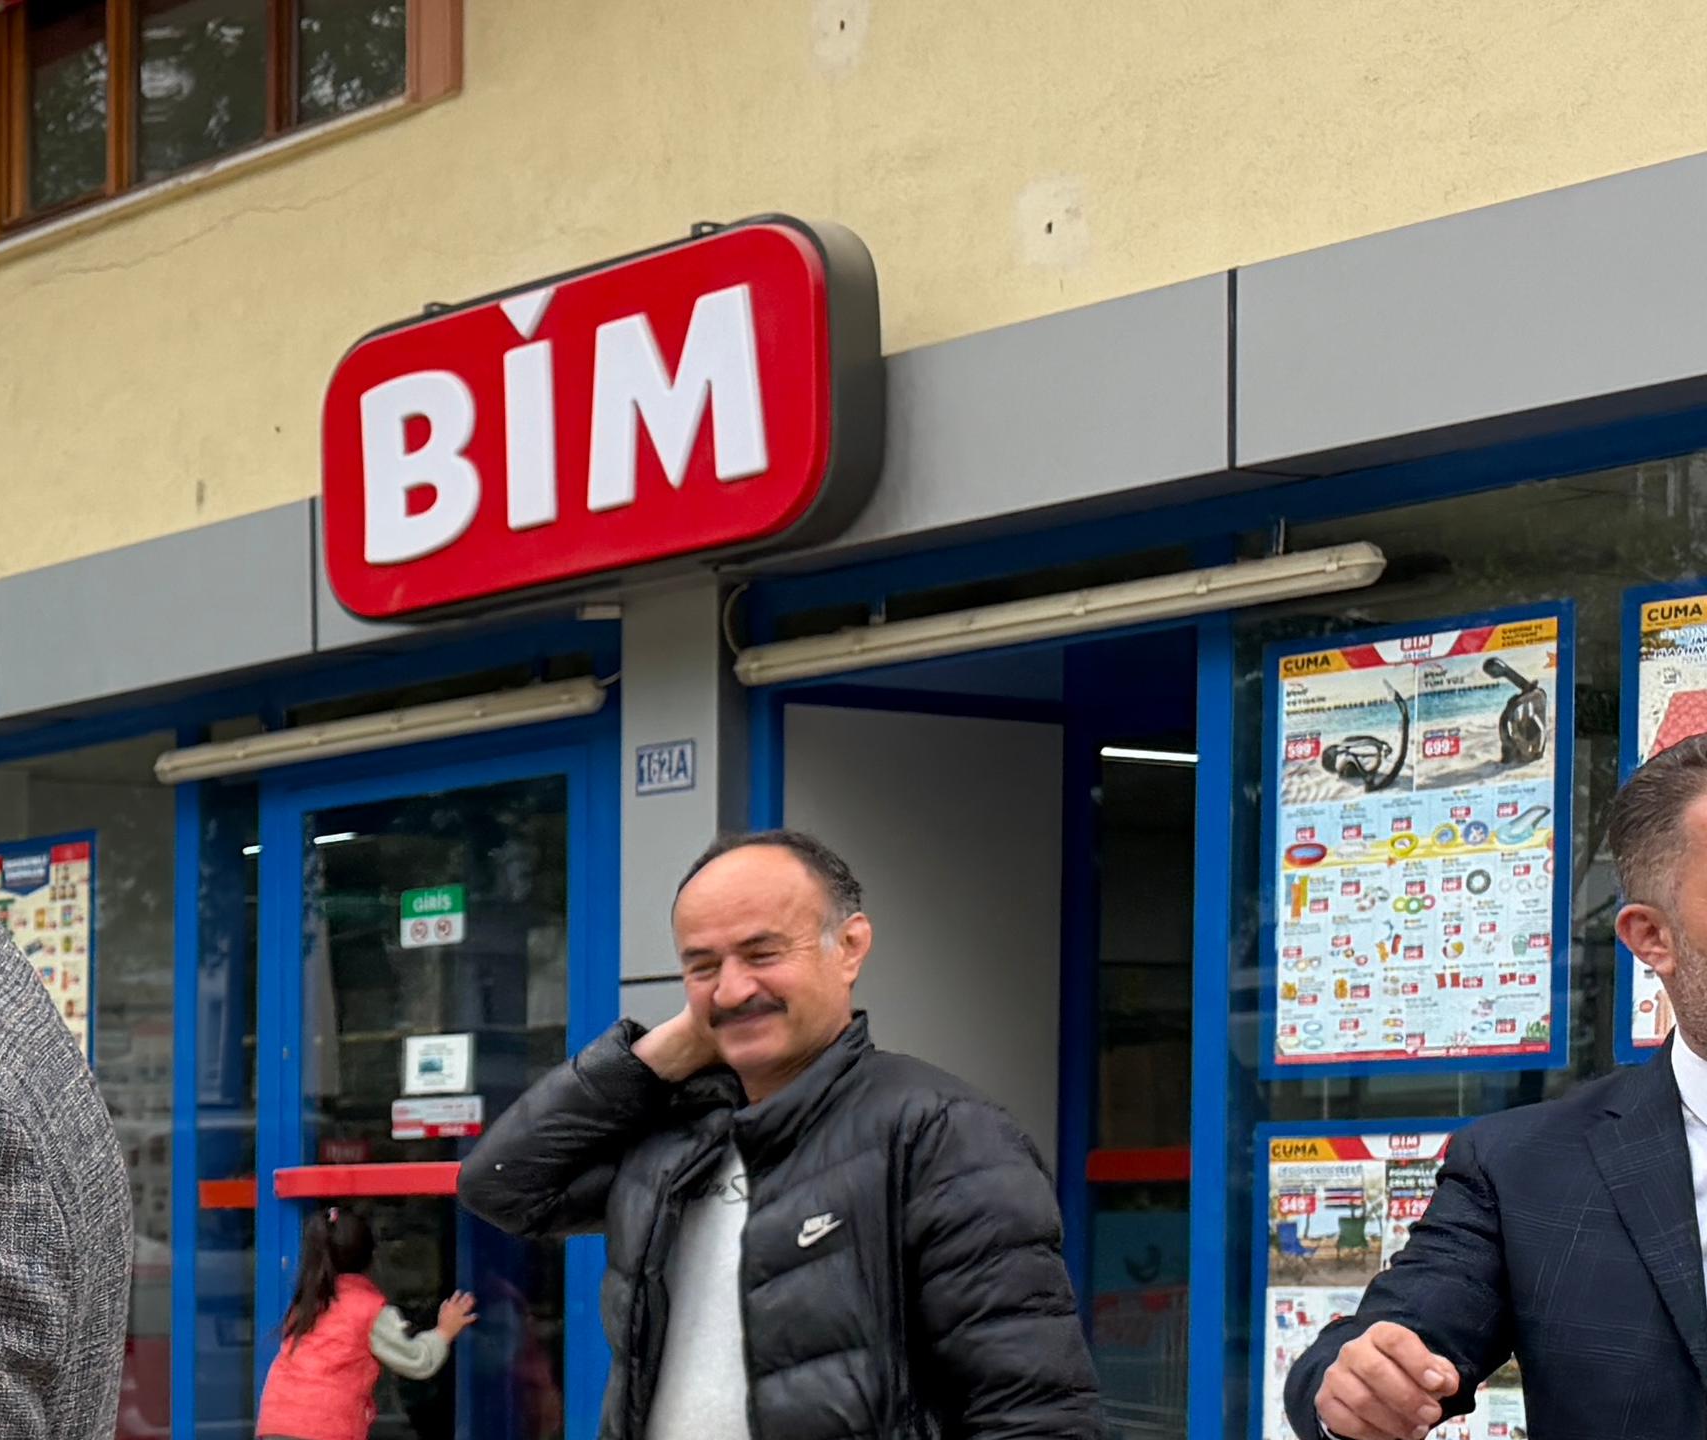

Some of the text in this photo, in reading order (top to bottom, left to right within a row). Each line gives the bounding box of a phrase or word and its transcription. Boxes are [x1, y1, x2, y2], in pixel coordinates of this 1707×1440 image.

[360, 284, 769, 566] BİM
[1647, 603, 1703, 622] CUMA
[1282, 654, 1331, 673] CUMA
[1272, 1142, 1319, 1159] CUMA
